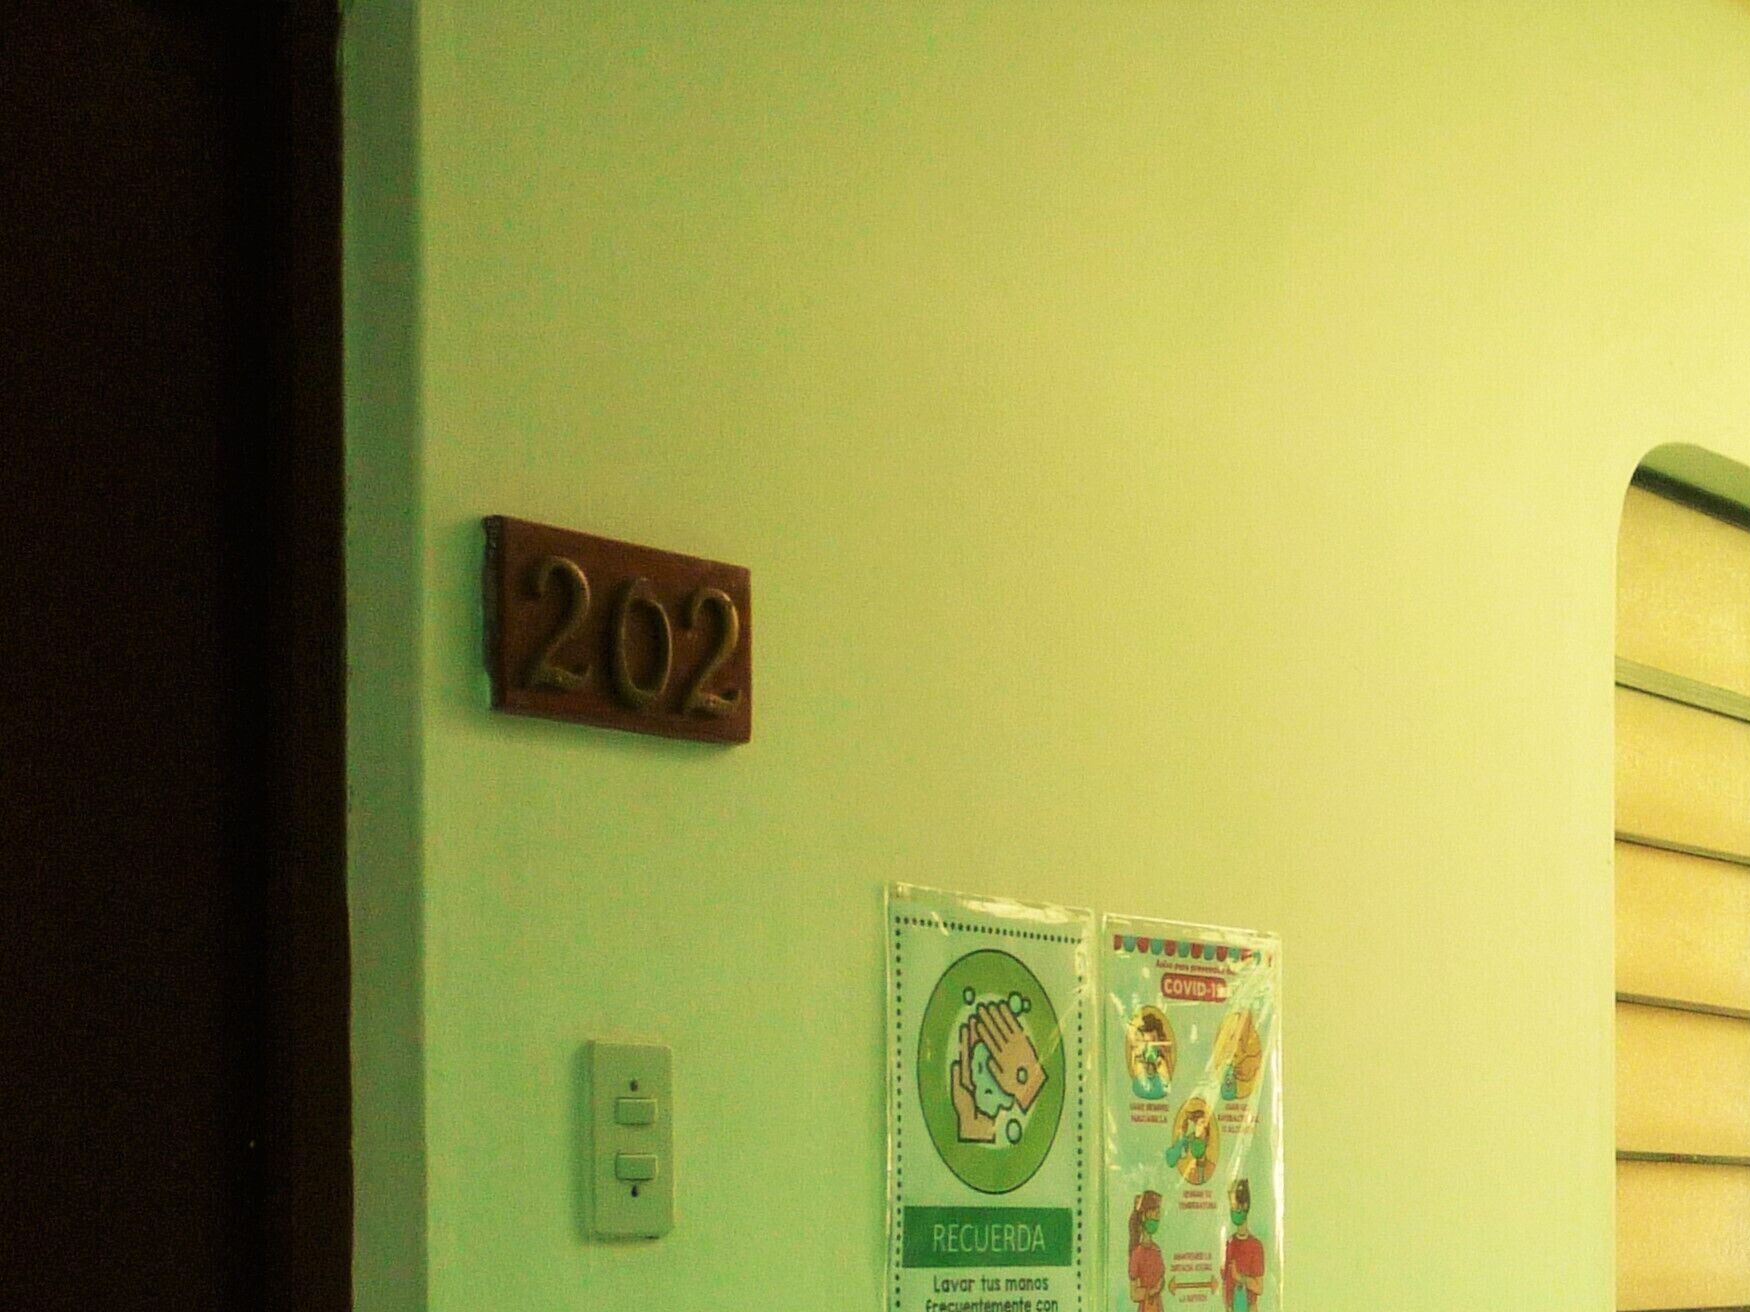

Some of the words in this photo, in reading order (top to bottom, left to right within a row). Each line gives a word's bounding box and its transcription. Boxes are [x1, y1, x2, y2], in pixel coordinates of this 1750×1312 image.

[532, 555, 740, 714] 202
[933, 1223, 1046, 1252] RECUERDA
[933, 1275, 975, 1293] Lavar
[981, 1275, 1000, 1291] tus
[1036, 1299, 1058, 1312] con
